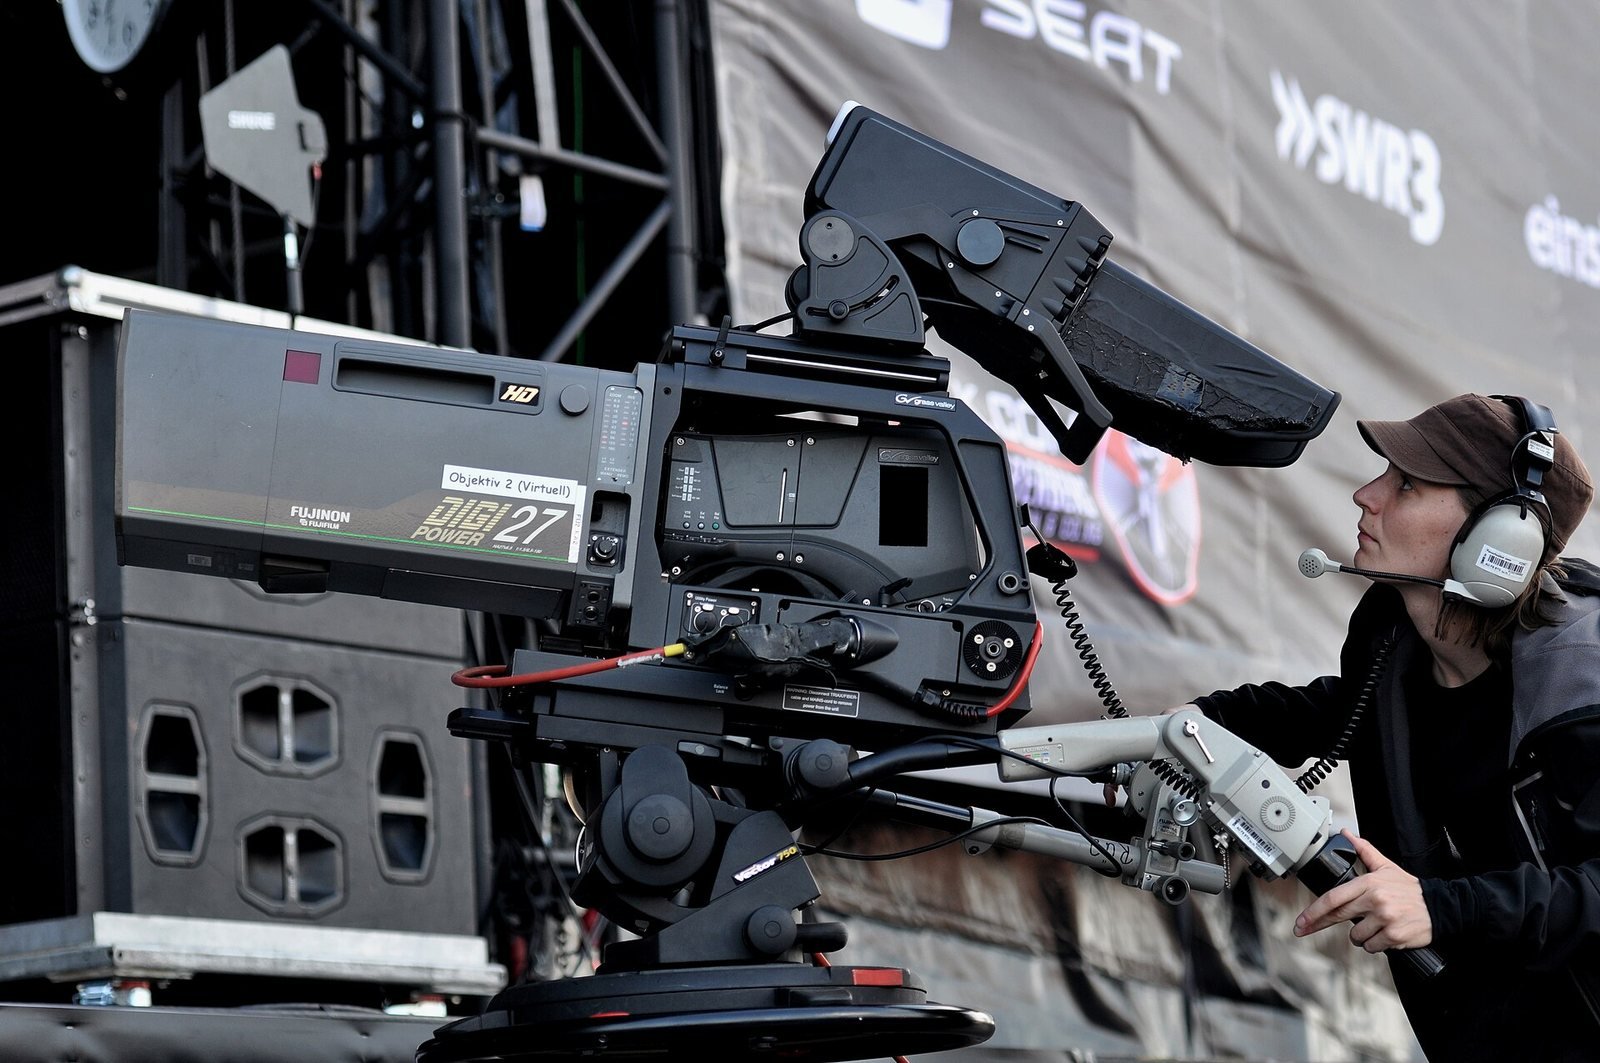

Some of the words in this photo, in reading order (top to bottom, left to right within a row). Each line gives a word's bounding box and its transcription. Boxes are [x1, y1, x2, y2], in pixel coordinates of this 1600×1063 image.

[1314, 93, 1445, 246] SWR3
[500, 384, 539, 403] HD
[449, 472, 500, 488] Objektiv
[505, 479, 513, 489] 2
[517, 480, 571, 498] (Virtuell)
[290, 505, 350, 523] FUJINON
[309, 520, 340, 530] FUJIFILM
[422, 496, 513, 532] DIGI
[492, 505, 568, 545] 27
[410, 526, 485, 547] POWER
[734, 857, 777, 882] Vector
[776, 846, 798, 861] 750
